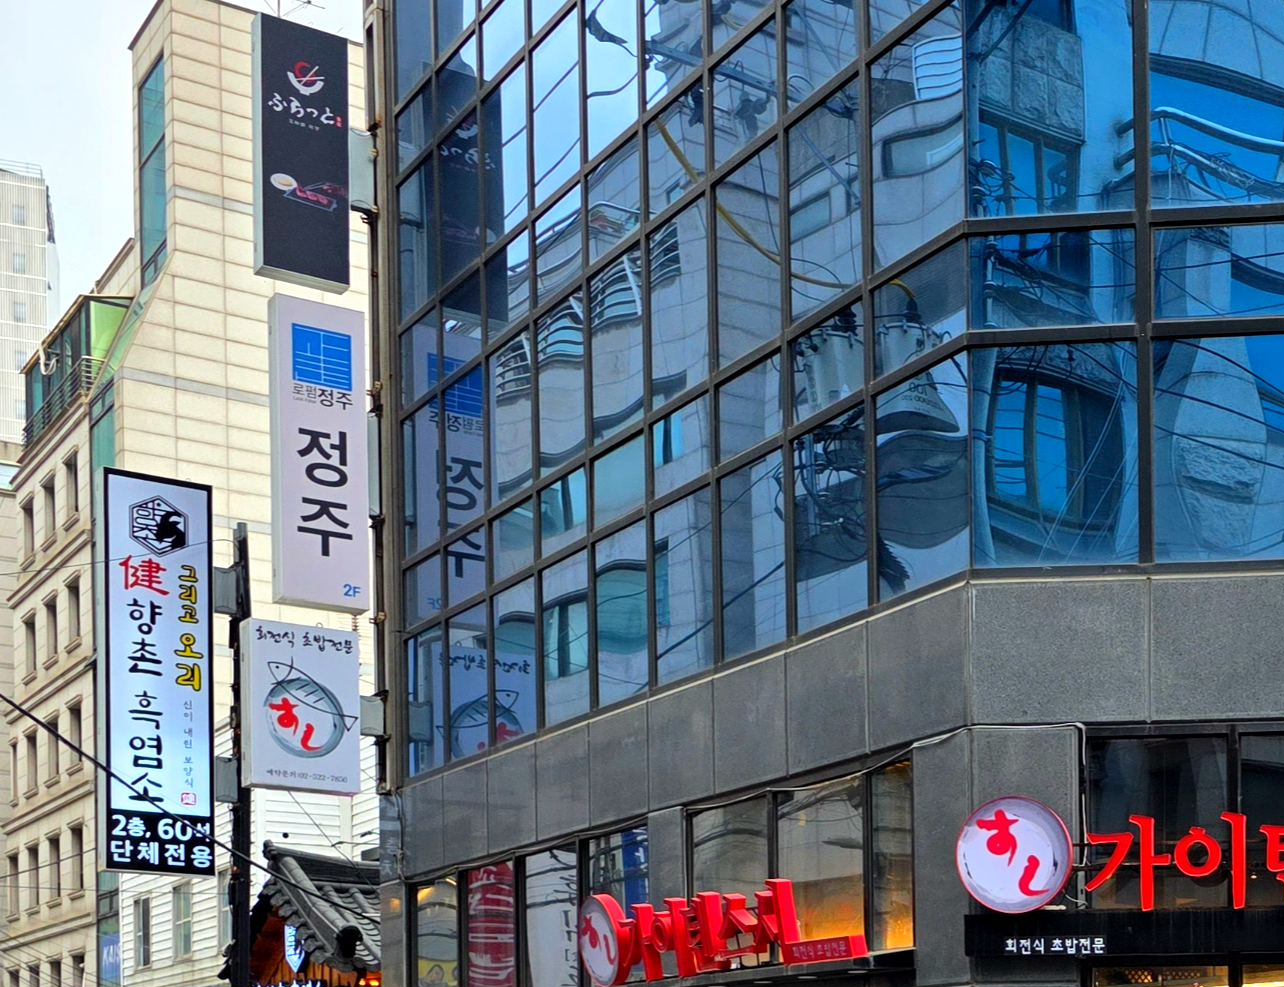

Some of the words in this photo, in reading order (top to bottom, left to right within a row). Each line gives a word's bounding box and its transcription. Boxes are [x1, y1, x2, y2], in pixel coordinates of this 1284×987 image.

[297, 427, 353, 557] 정주
[178, 564, 199, 624] 그리고
[343, 583, 361, 598] 2F
[256, 625, 295, 648] 회전식
[302, 631, 354, 654] 초밥전문
[173, 633, 204, 691] 오리
[183, 700, 193, 722] 신이
[128, 690, 164, 802] 흑염소
[183, 727, 193, 749] 내린
[183, 756, 194, 788] 보양식
[111, 814, 152, 838] 2층,
[110, 839, 213, 868] 단체전용
[616, 878, 801, 983] 가이텐스시
[1005, 938, 1045, 955] 회전식
[1050, 938, 1106, 955] 초밥전문
